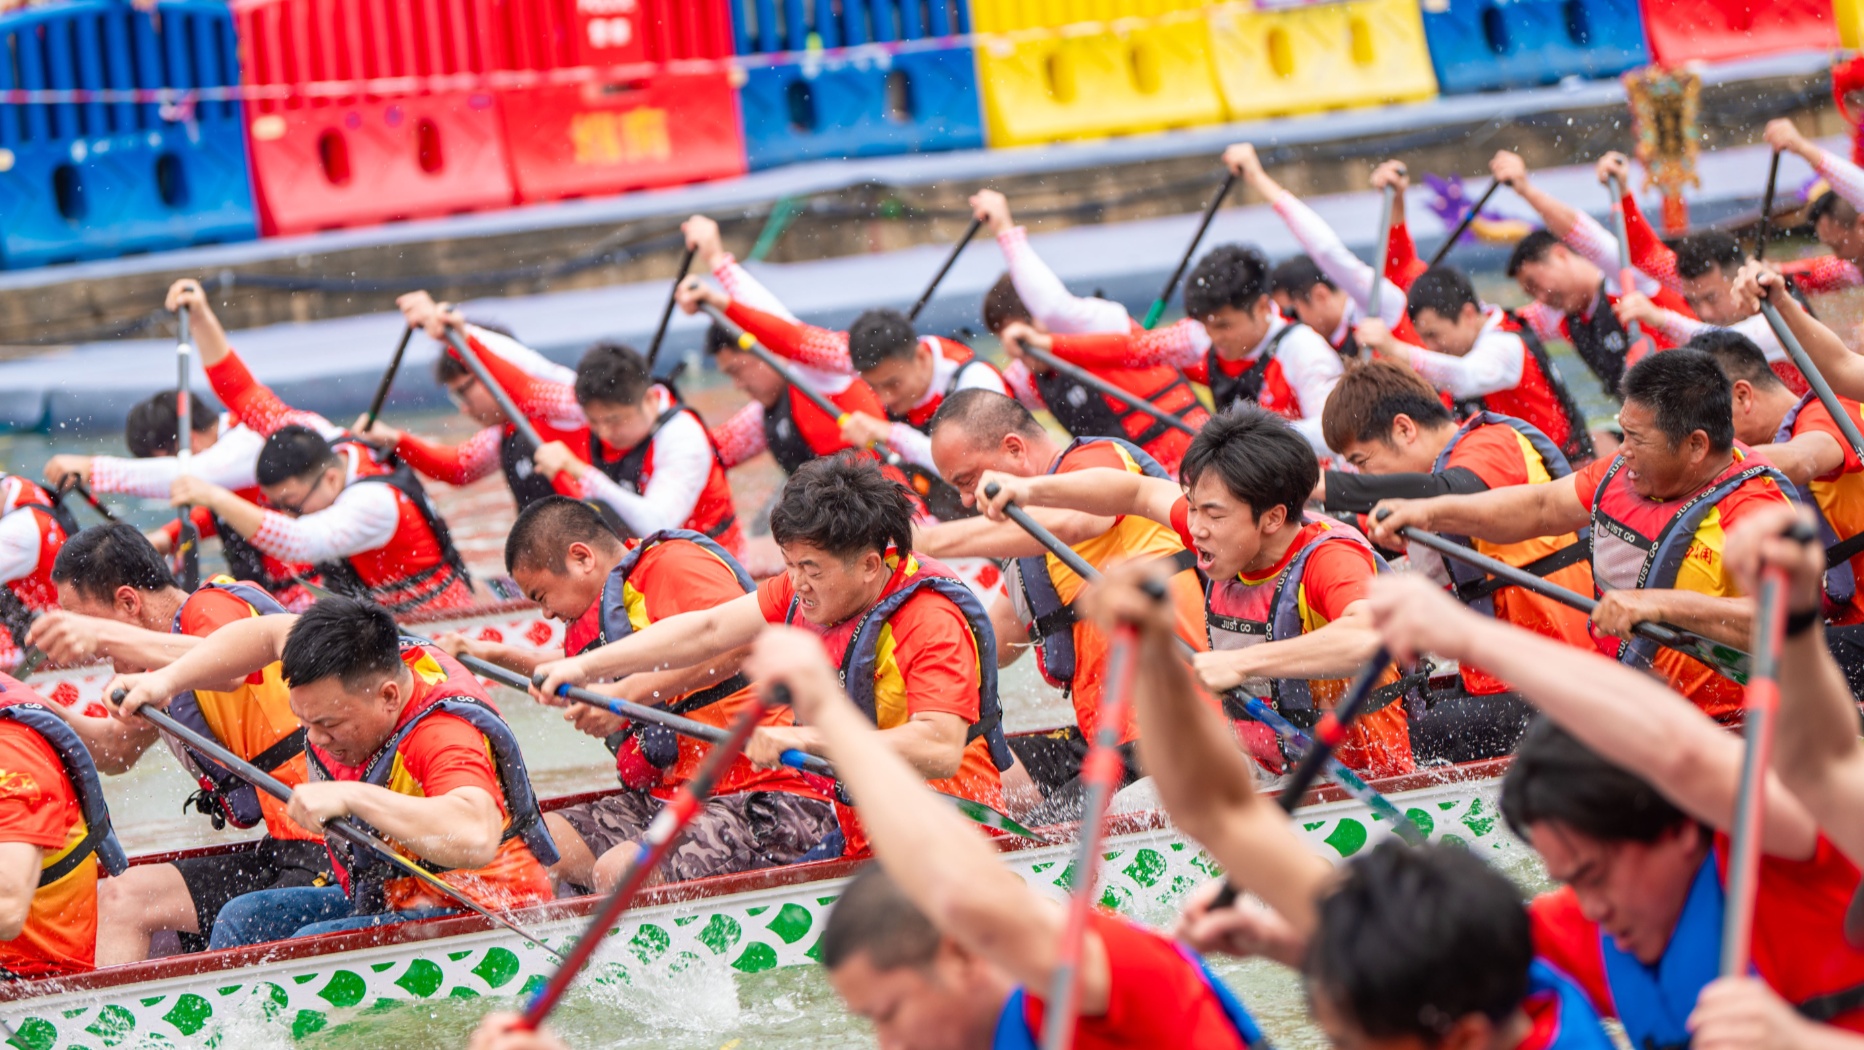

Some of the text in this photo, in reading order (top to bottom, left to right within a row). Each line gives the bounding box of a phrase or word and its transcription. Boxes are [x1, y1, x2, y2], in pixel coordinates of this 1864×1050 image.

[1676, 486, 1716, 519] JUST GO
[1605, 520, 1636, 544] JUST GO
[1637, 540, 1659, 589] JUST GO
[1276, 565, 1292, 593] JUST
[851, 614, 869, 642] JUST
[1221, 619, 1252, 633] JUST GO
[1265, 622, 1273, 641] GO
[838, 670, 846, 689] GO
[24, 702, 43, 710] GO
[456, 695, 476, 703] GO
[364, 732, 400, 778] JUST GO
